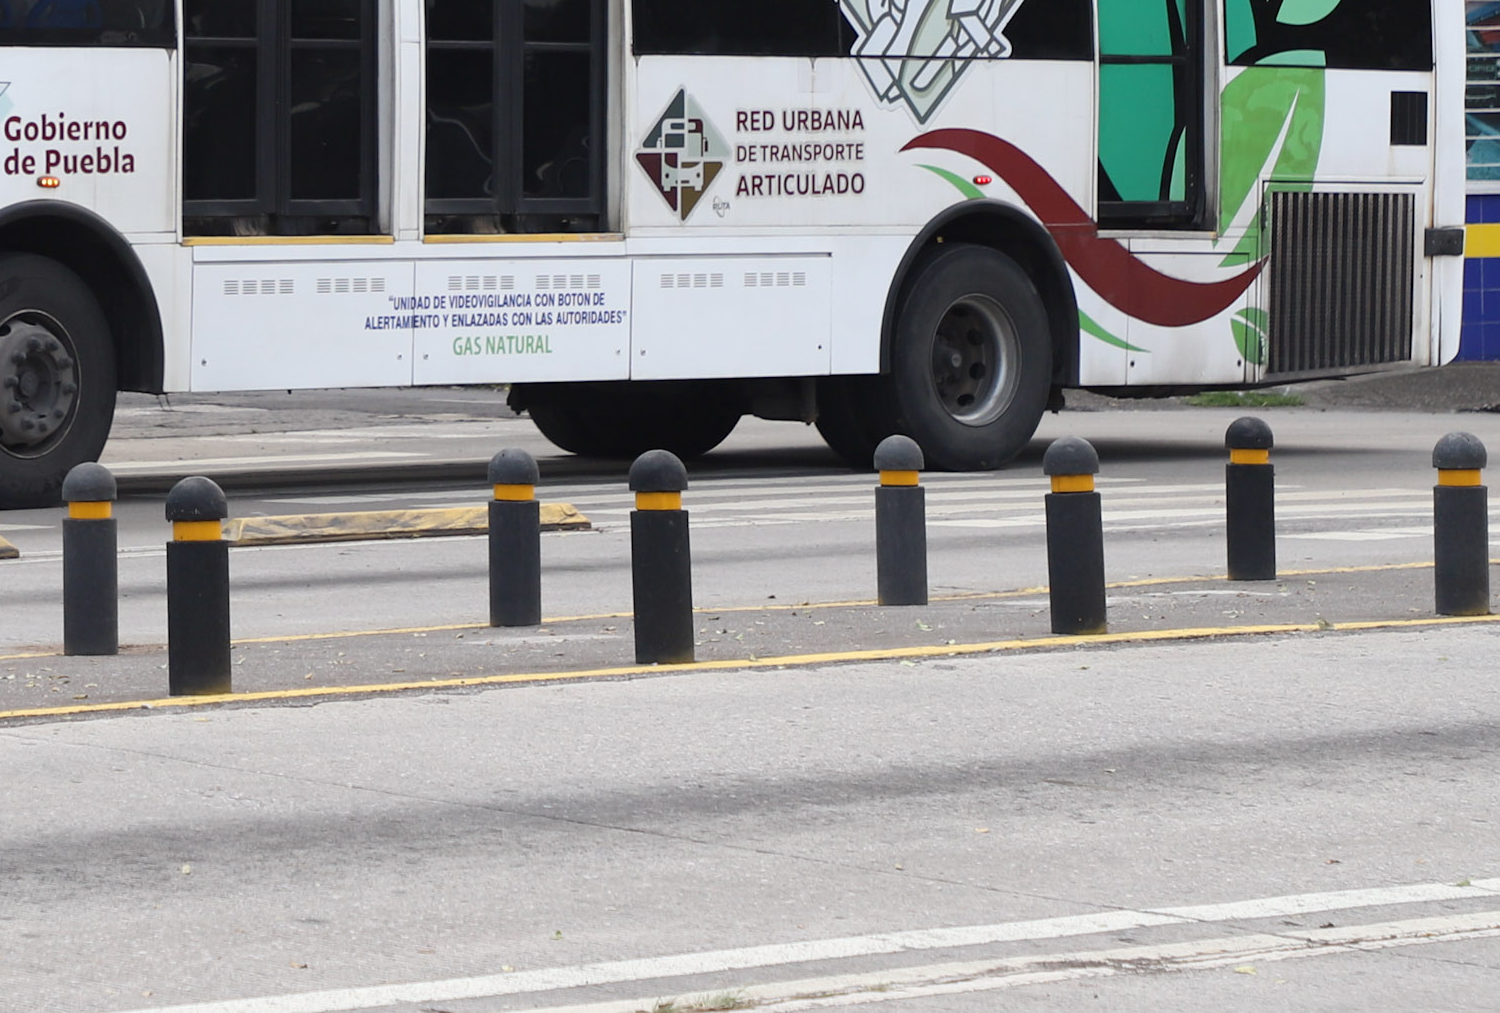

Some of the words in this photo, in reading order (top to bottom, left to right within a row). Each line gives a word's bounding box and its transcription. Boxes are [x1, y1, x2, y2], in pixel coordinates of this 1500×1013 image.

[4, 112, 127, 141] Gobierno
[736, 110, 775, 131] RED
[782, 110, 864, 131] URBANA
[4, 147, 36, 175] de
[45, 147, 135, 174] Puebla
[737, 145, 757, 162] DE
[760, 143, 864, 162] TRANSPORTE
[736, 173, 865, 196] ARTICULADO
[433, 295, 446, 309] DE
[449, 294, 532, 309] VIDEOVIGILANCIA
[534, 293, 555, 307] CON
[558, 292, 591, 307] BOTON
[592, 292, 605, 306] DE
[364, 314, 440, 330] ALERTAMIENTO
[442, 314, 449, 328] Y
[451, 313, 508, 327] ENLAZADAS
[512, 312, 532, 326] CON
[535, 311, 553, 326] LAS
[452, 336, 482, 356] GAS
[485, 335, 553, 355] NATURAL
